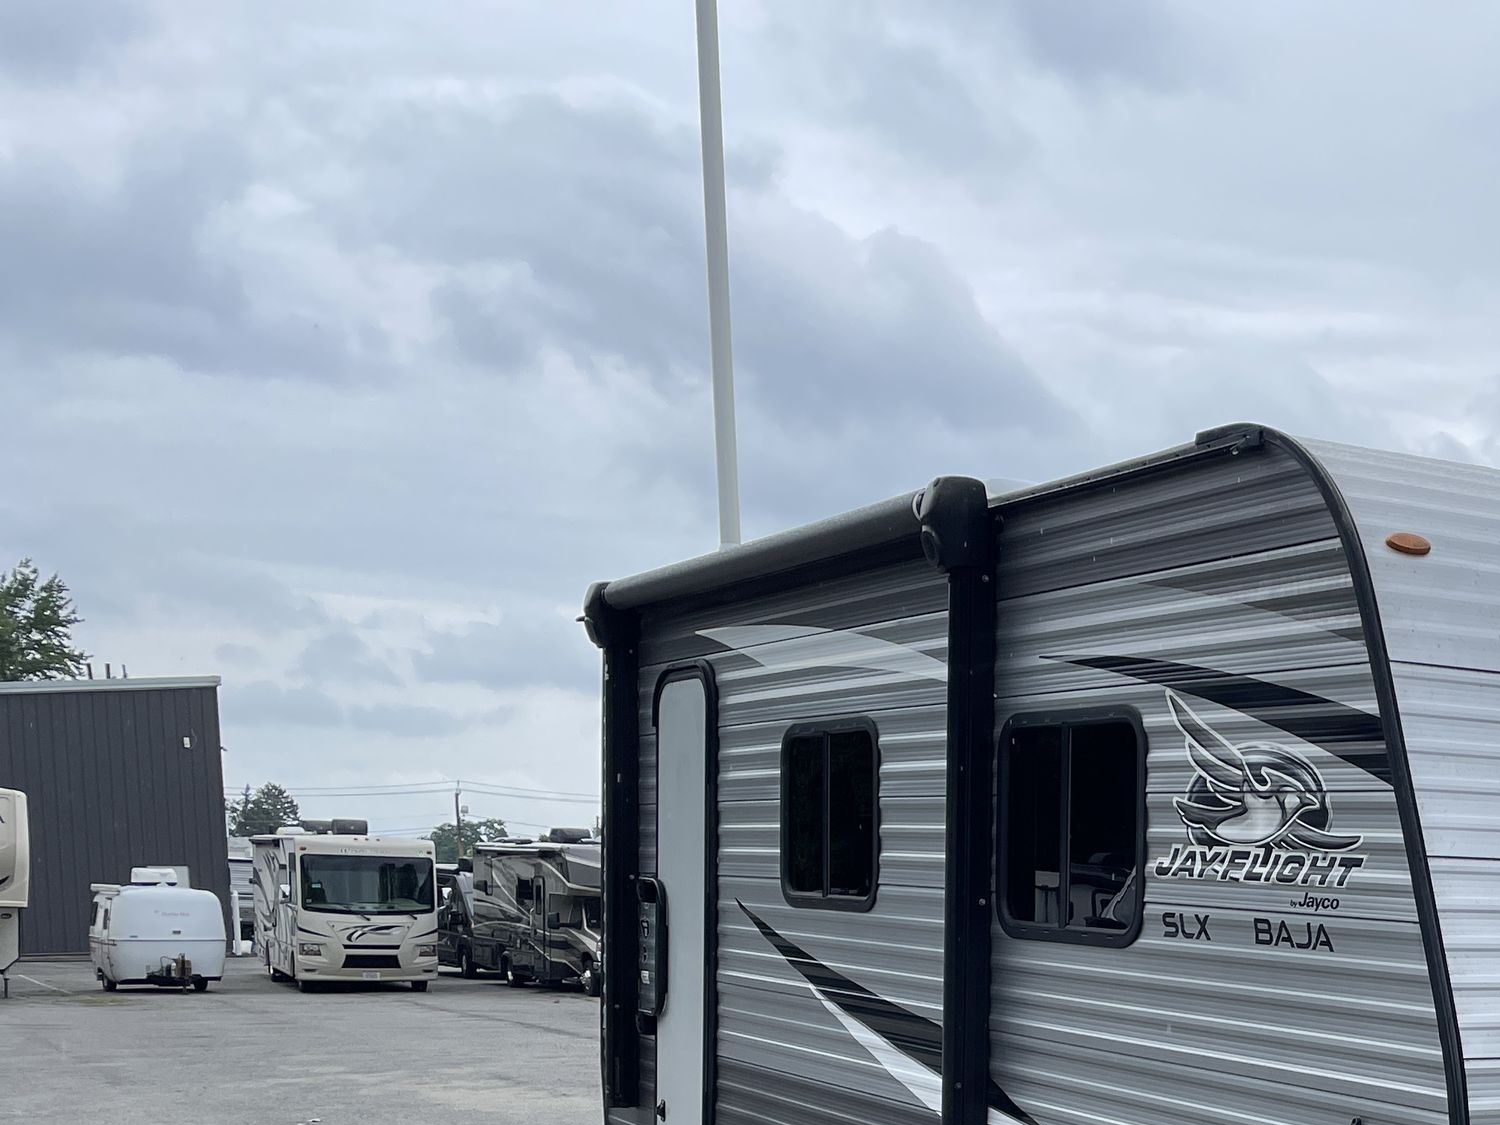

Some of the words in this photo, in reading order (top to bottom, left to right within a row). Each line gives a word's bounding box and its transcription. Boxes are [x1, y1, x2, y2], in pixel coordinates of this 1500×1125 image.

[1298, 892, 1340, 912] Jayco
[1162, 912, 1212, 941] SLX
[1253, 917, 1335, 952] BAJA
